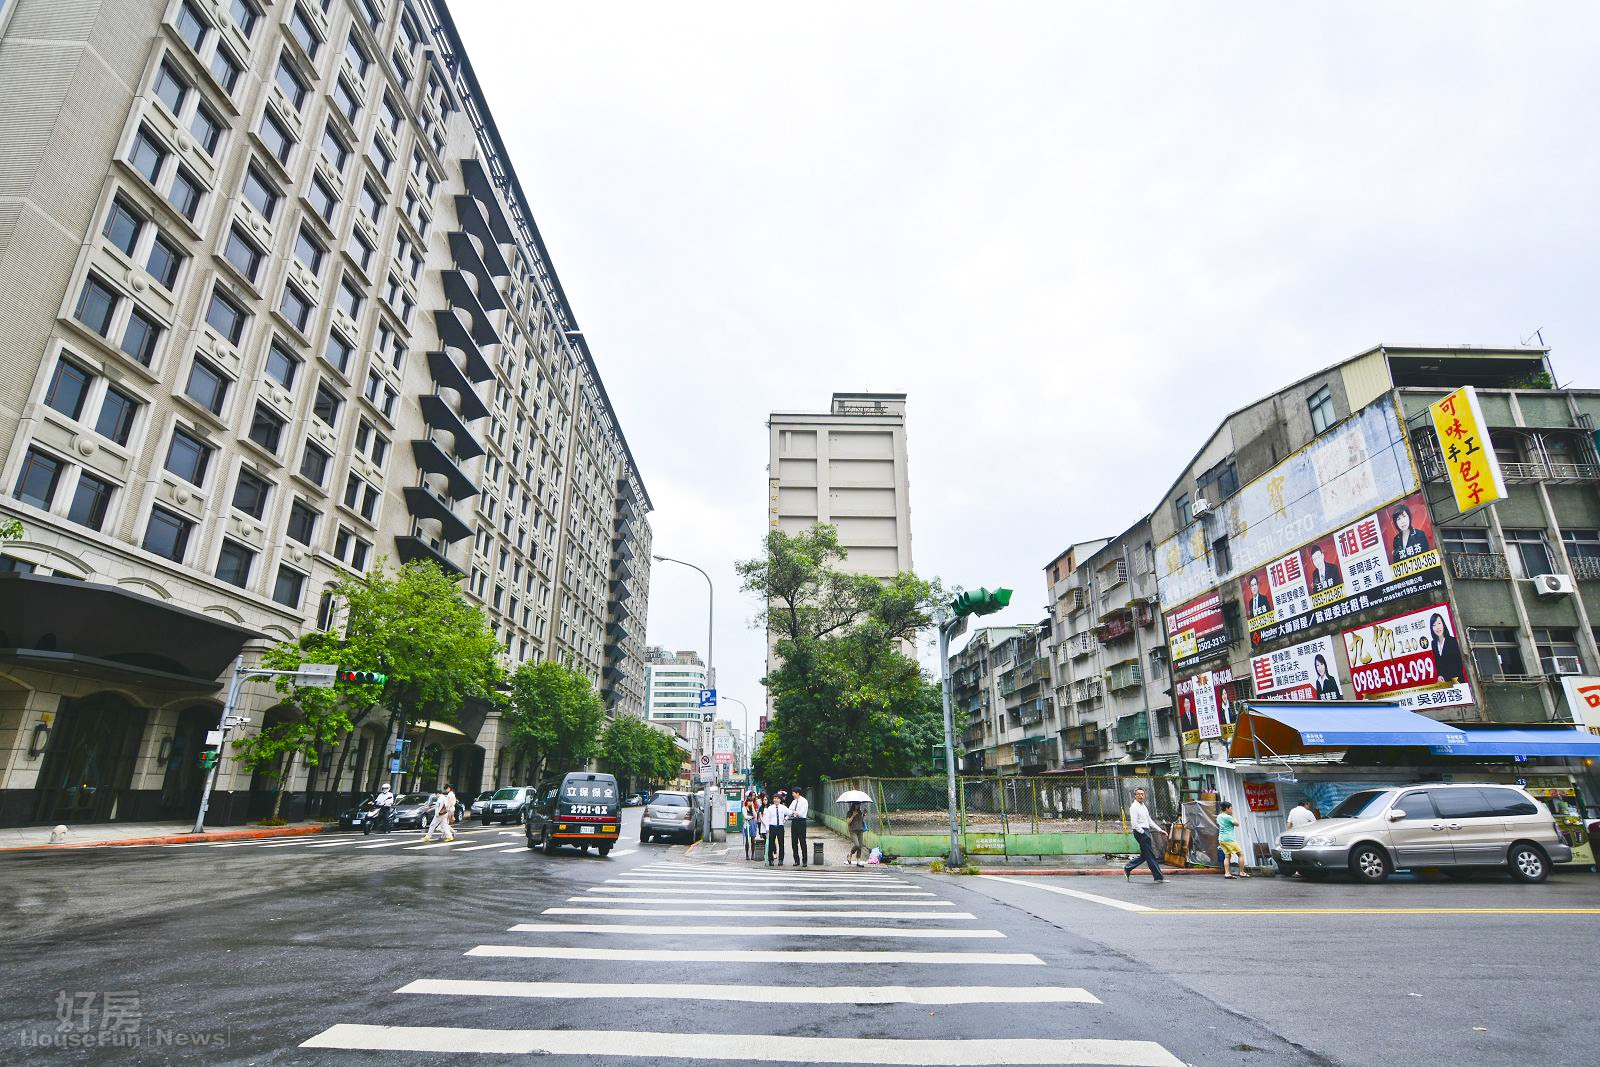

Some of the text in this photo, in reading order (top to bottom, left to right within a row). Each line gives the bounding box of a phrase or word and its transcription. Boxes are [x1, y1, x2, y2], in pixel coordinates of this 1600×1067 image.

[1338, 520, 1379, 557] 租售
[1270, 556, 1301, 588] 租售
[1348, 556, 1381, 577] 華爾道夫
[1392, 552, 1437, 578] 0970-730-368
[1370, 579, 1442, 606] www.master1995.com.tw
[1297, 641, 1326, 656] 華爾道夫
[1253, 657, 1274, 691] 售
[1352, 657, 1435, 692] 0988-812-099
[567, 787, 613, 798] 立保保全
